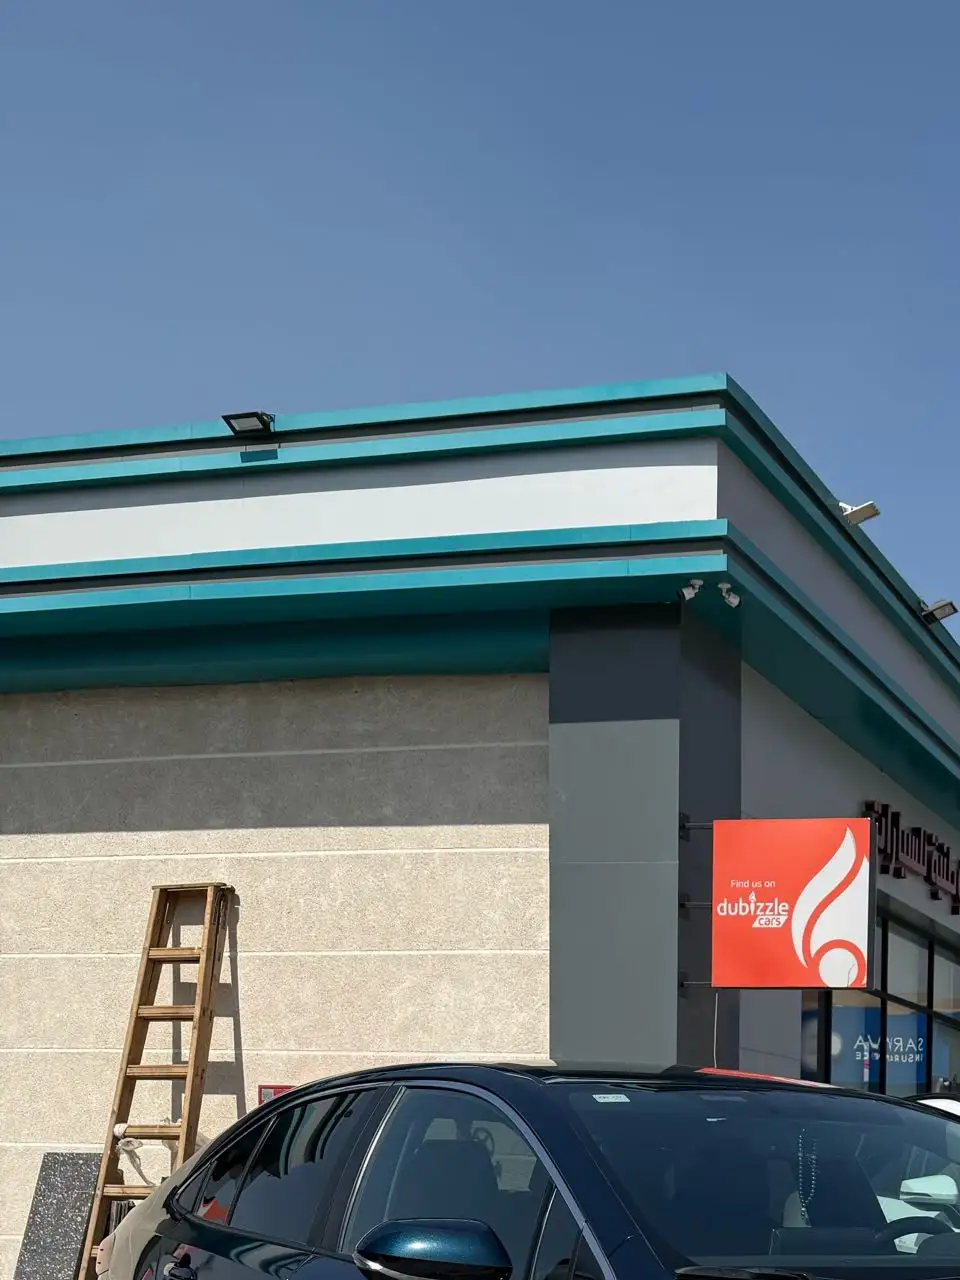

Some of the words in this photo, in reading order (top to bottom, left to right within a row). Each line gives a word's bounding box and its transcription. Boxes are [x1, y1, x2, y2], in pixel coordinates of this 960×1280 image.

[730, 879, 750, 888] Find
[752, 880, 762, 888] us
[764, 880, 776, 888] on
[716, 891, 789, 916] dubizzle
[758, 917, 781, 926] cars
